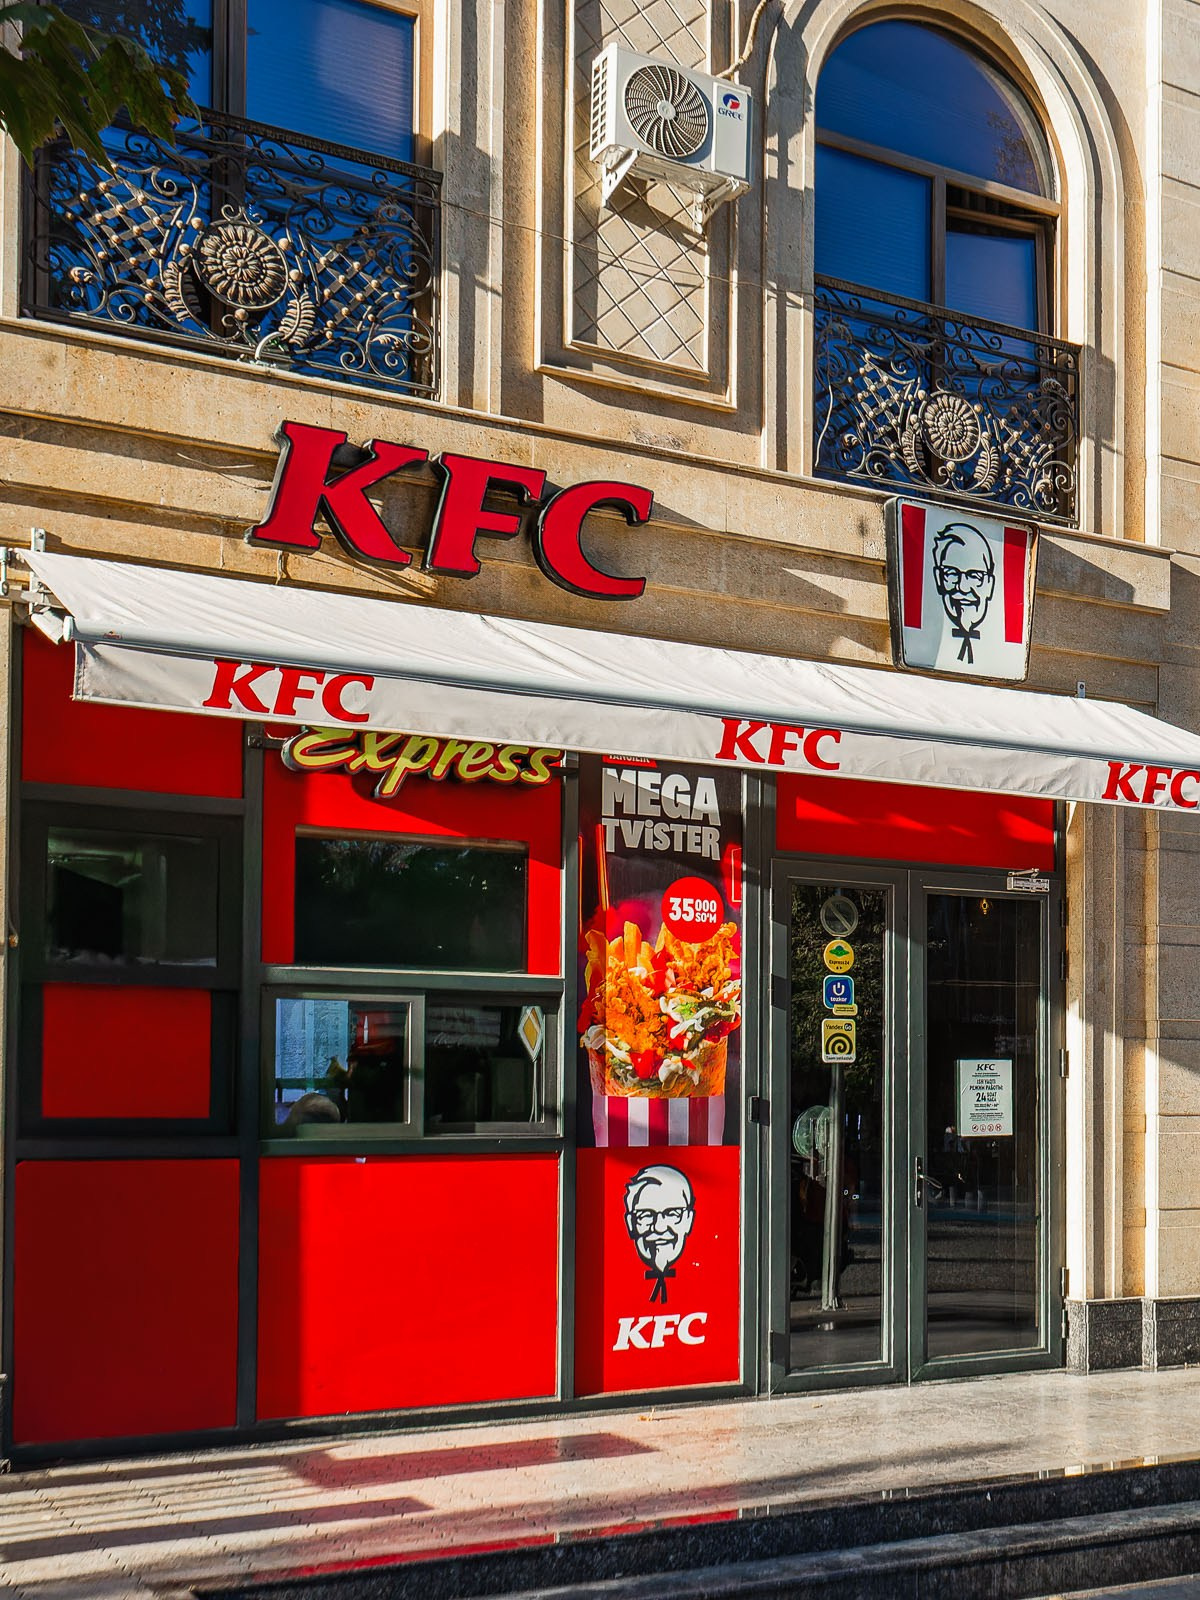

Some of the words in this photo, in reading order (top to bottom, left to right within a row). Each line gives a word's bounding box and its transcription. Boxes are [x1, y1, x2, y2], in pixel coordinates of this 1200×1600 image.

[245, 420, 653, 600] KFC
[203, 658, 375, 723] KFC
[285, 725, 563, 798] Express
[715, 717, 842, 771] KFC
[601, 767, 721, 826] MEGA
[1101, 760, 1200, 808] KFC
[669, 897, 695, 922] 35
[694, 899, 717, 914] 000
[825, 1023, 843, 1031] Yandex
[843, 1023, 853, 1031] Go
[976, 1063, 996, 1071] KFC
[976, 1092, 987, 1102] 24
[612, 1312, 708, 1352] KFC
